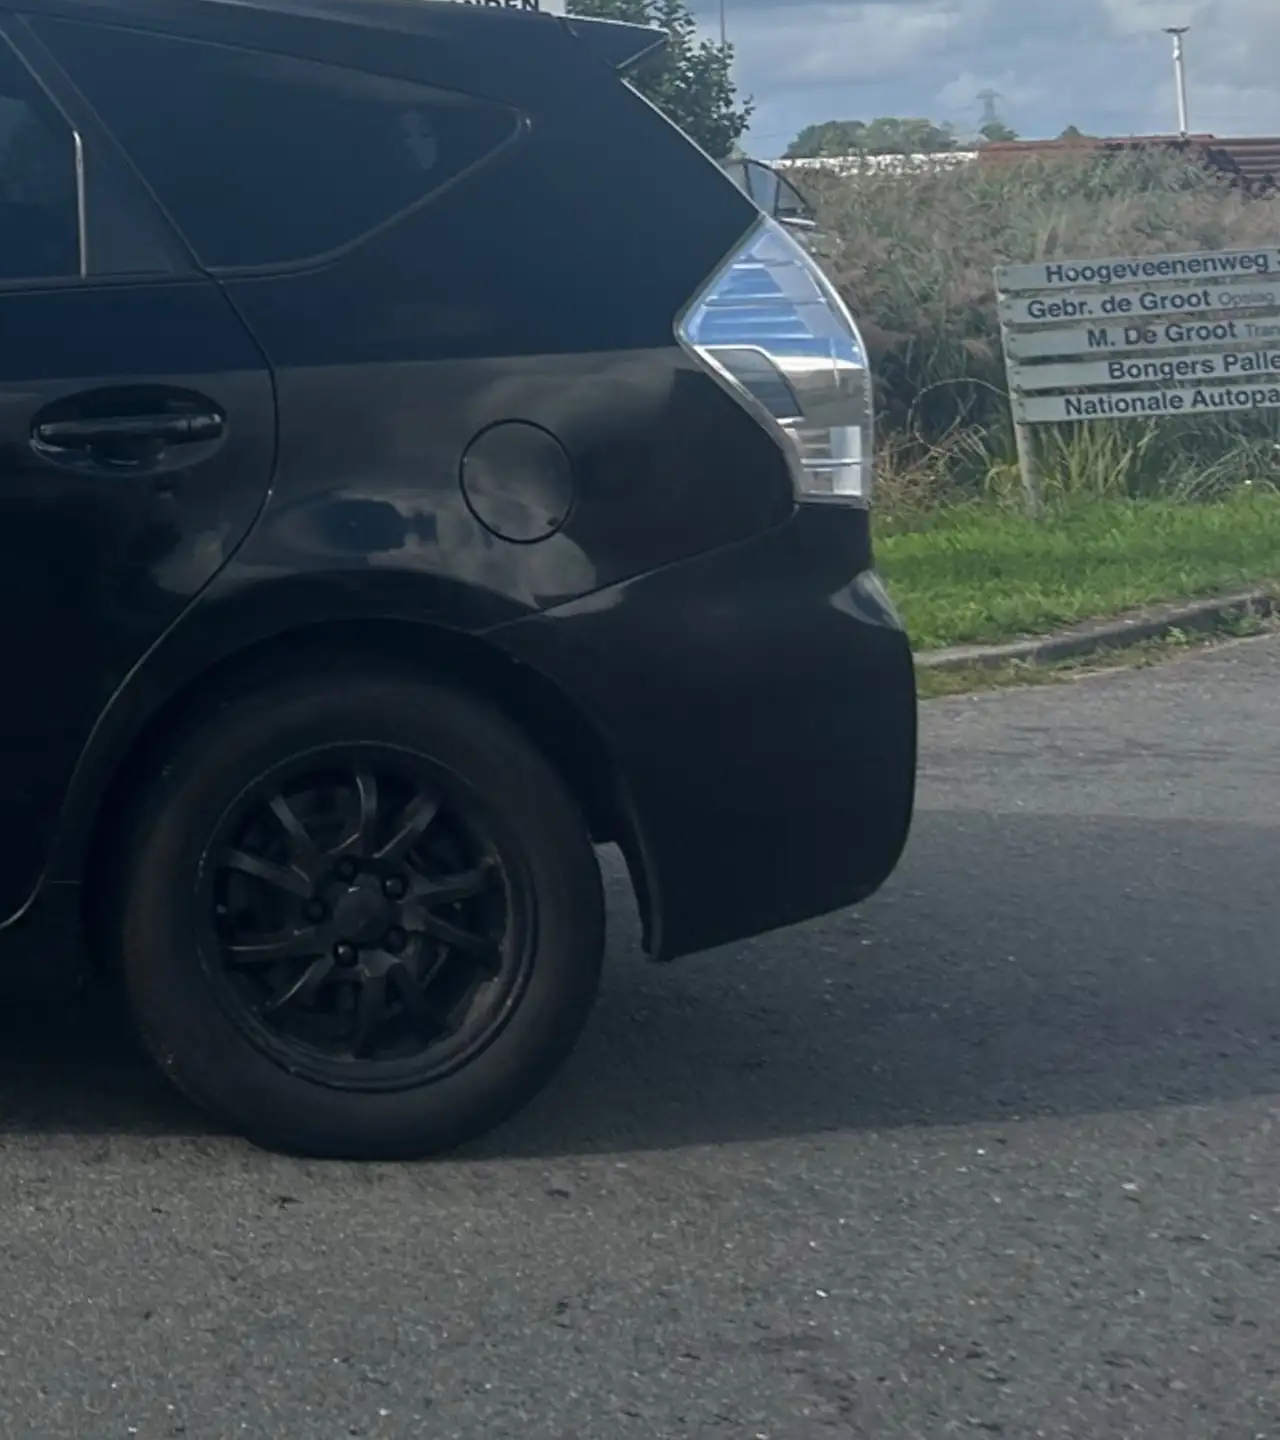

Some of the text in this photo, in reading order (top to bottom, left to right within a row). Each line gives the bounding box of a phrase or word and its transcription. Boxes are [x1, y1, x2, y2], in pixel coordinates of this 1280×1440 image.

[1045, 252, 1269, 284] Hoogeveenenweg
[1027, 298, 1093, 319] Gebr.
[1100, 295, 1133, 314] de
[1139, 289, 1212, 311] Groot
[1086, 328, 1116, 348] M.
[1124, 327, 1158, 345] De
[1164, 321, 1238, 343] Groot
[1108, 357, 1215, 381] Bongers
[1064, 392, 1185, 417] Nationale
